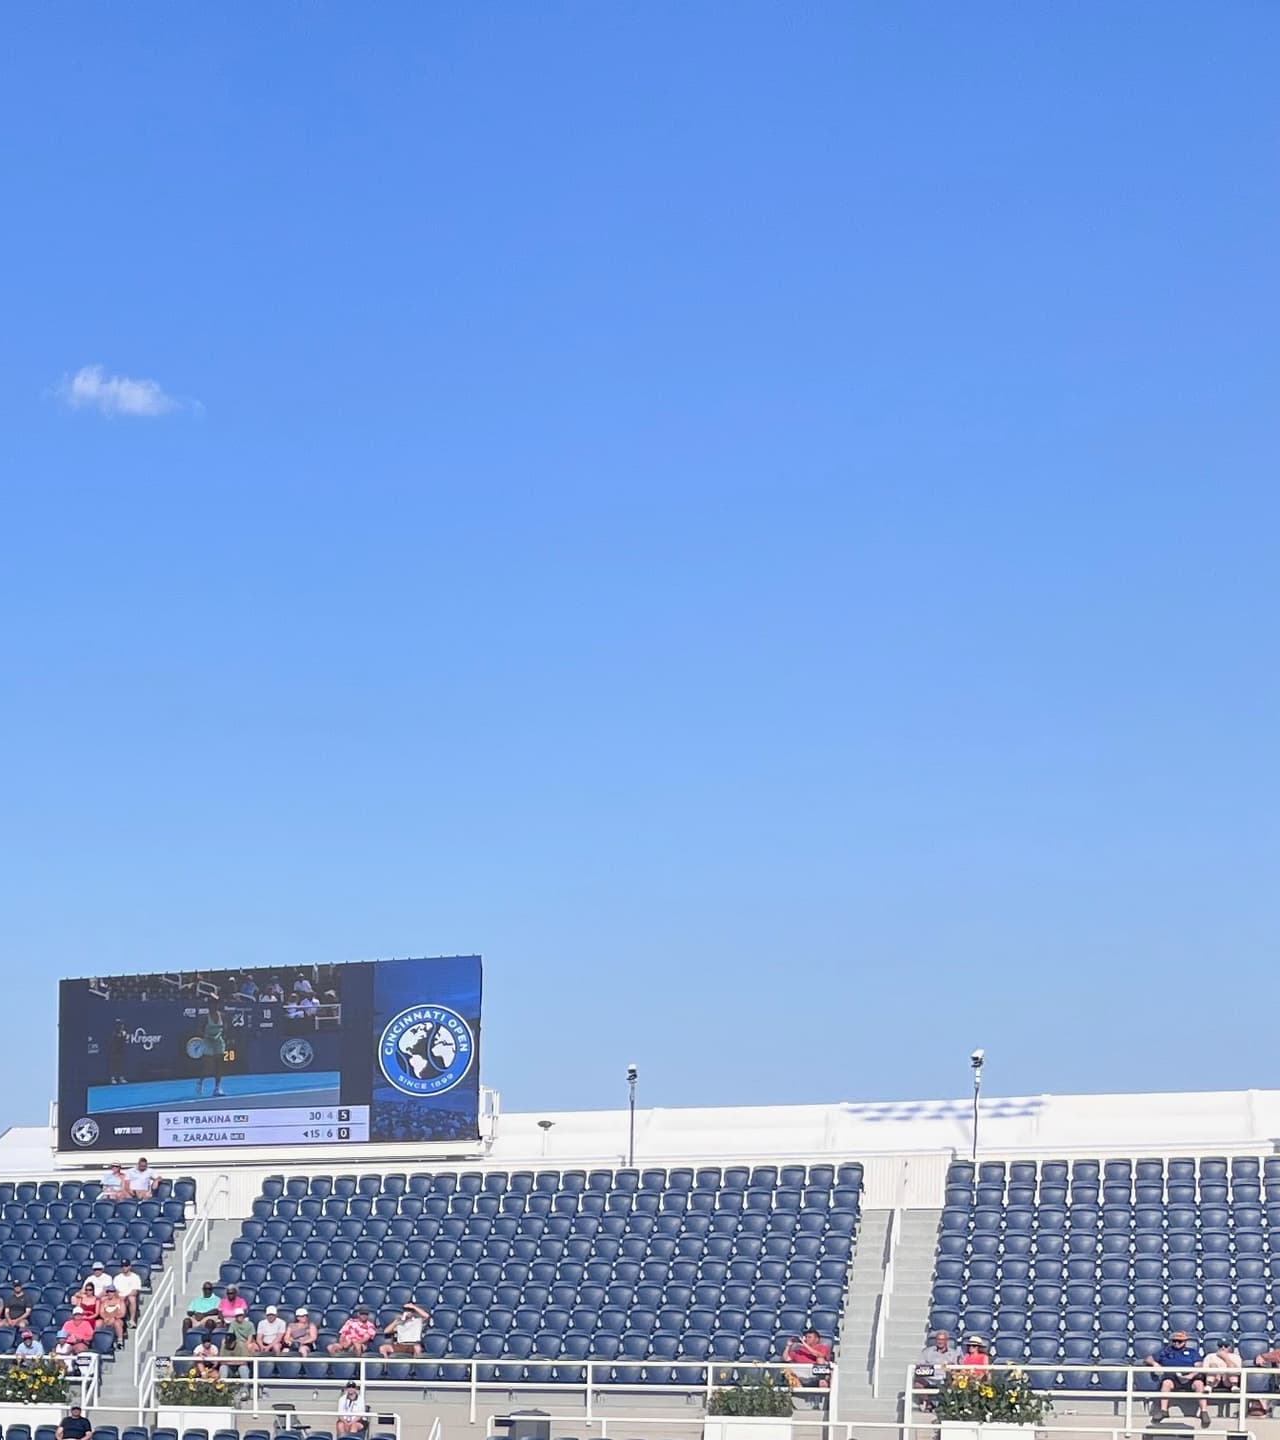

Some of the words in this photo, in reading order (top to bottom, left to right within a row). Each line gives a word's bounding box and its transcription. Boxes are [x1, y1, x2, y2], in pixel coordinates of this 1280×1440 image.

[385, 1010, 446, 1055] CINCINNATI
[448, 1019, 468, 1052] OPEN
[398, 1075, 427, 1089] SINCE
[183, 1114, 231, 1125] RYBAKINA
[309, 1111, 321, 1121] 30
[183, 1132, 228, 1142] ZARAZUA
[310, 1130, 320, 1138] 15
[327, 1129, 333, 1138] 6
